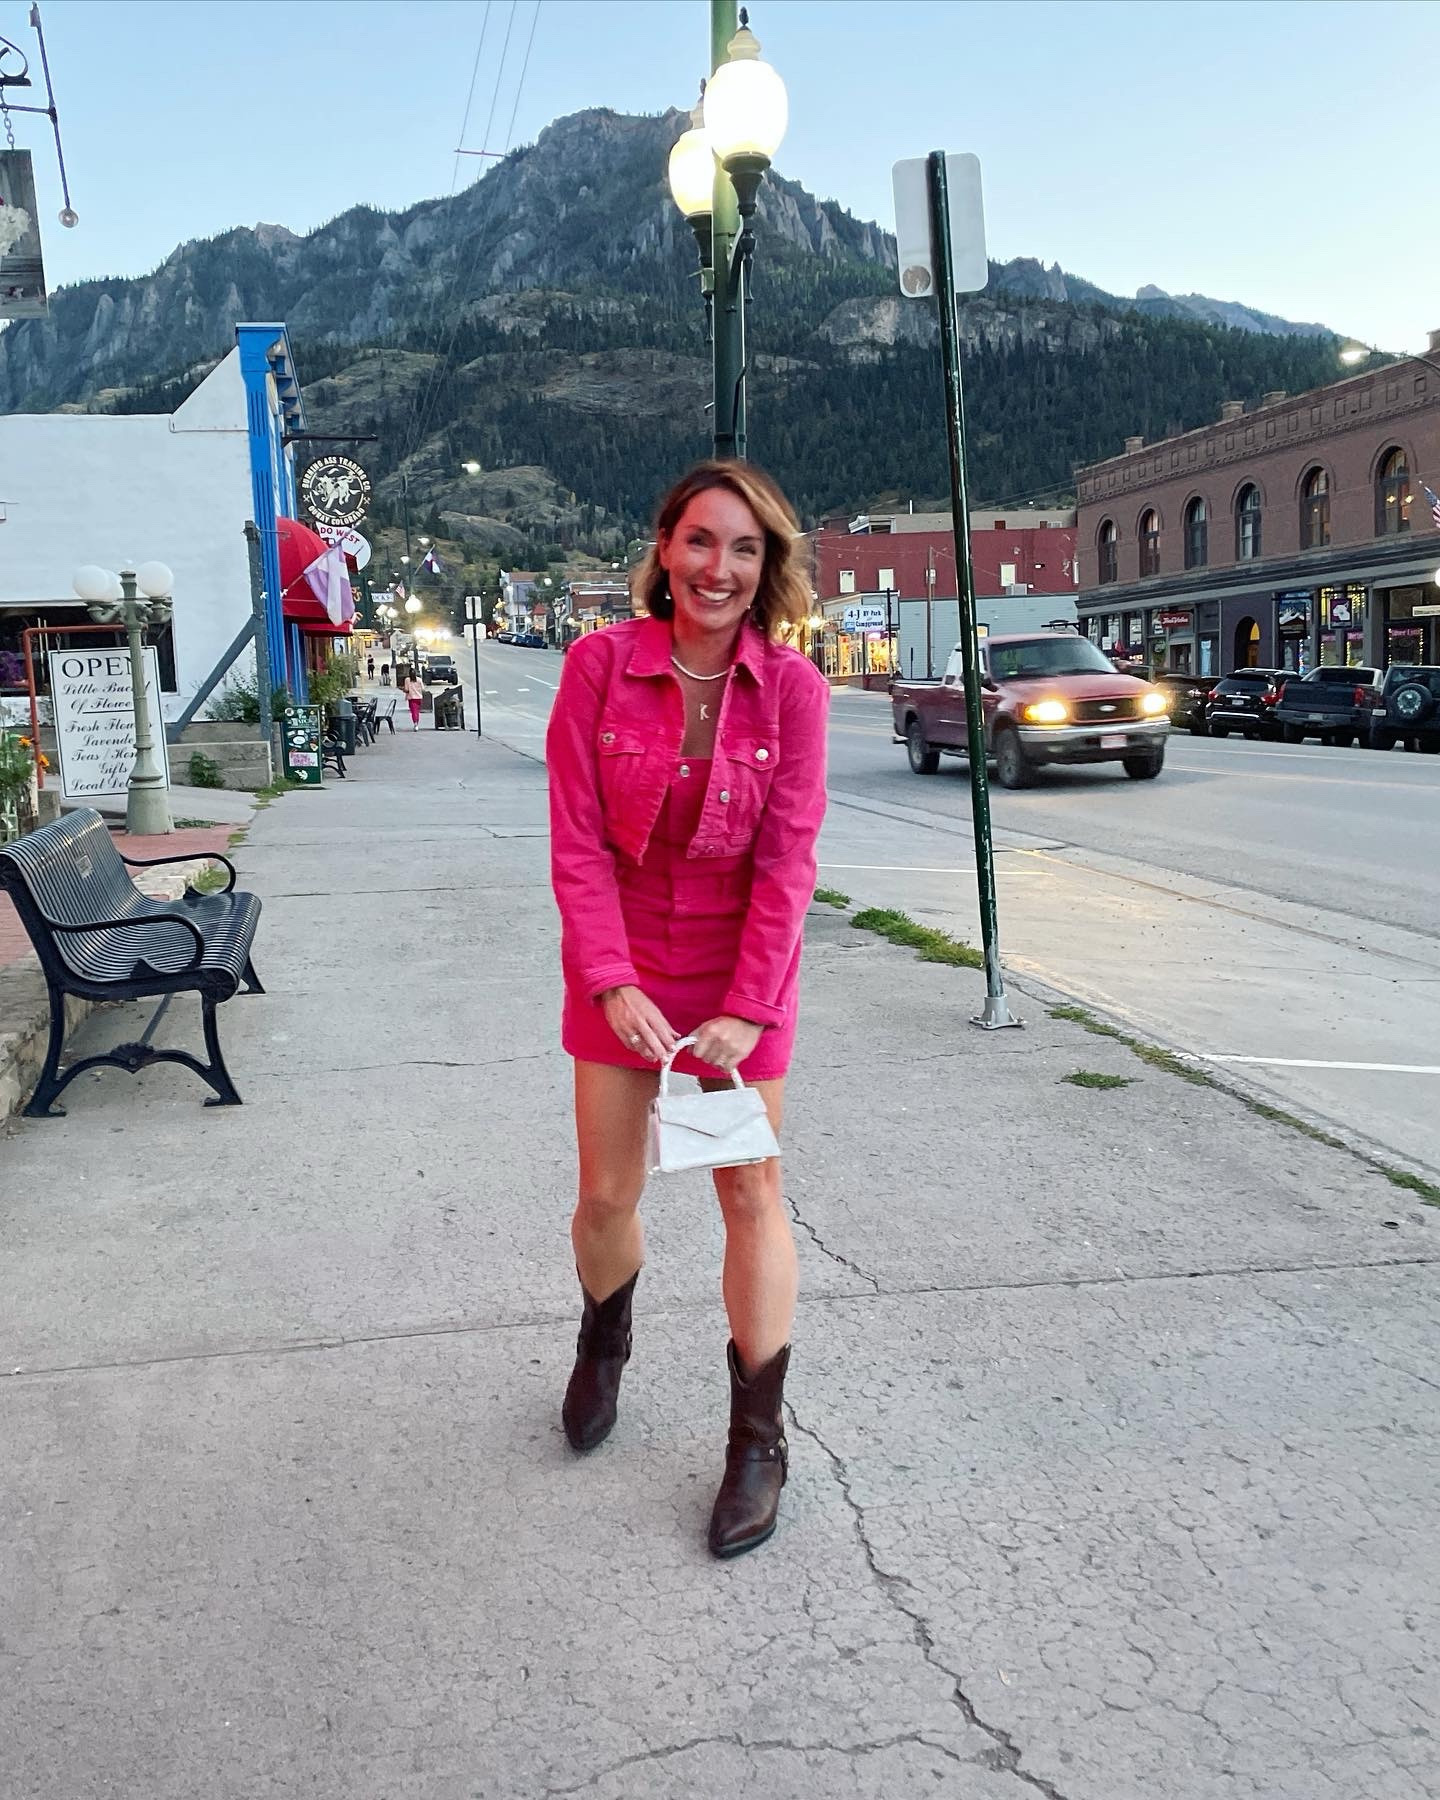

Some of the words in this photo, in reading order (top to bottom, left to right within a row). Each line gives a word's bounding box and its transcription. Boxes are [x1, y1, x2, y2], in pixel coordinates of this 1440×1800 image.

[301, 460, 324, 489] BURNING
[323, 456, 337, 465] ASS
[339, 456, 367, 481] TRADING
[308, 505, 330, 523] OURAY
[331, 507, 365, 526] COLORADO
[90, 697, 131, 709] Flowe
[65, 720, 100, 733] Fresh
[83, 733, 134, 746] Lavende
[71, 749, 99, 761] Teas
[111, 747, 137, 759] Hon
[98, 762, 128, 779] Gifts
[71, 778, 105, 791] Local
